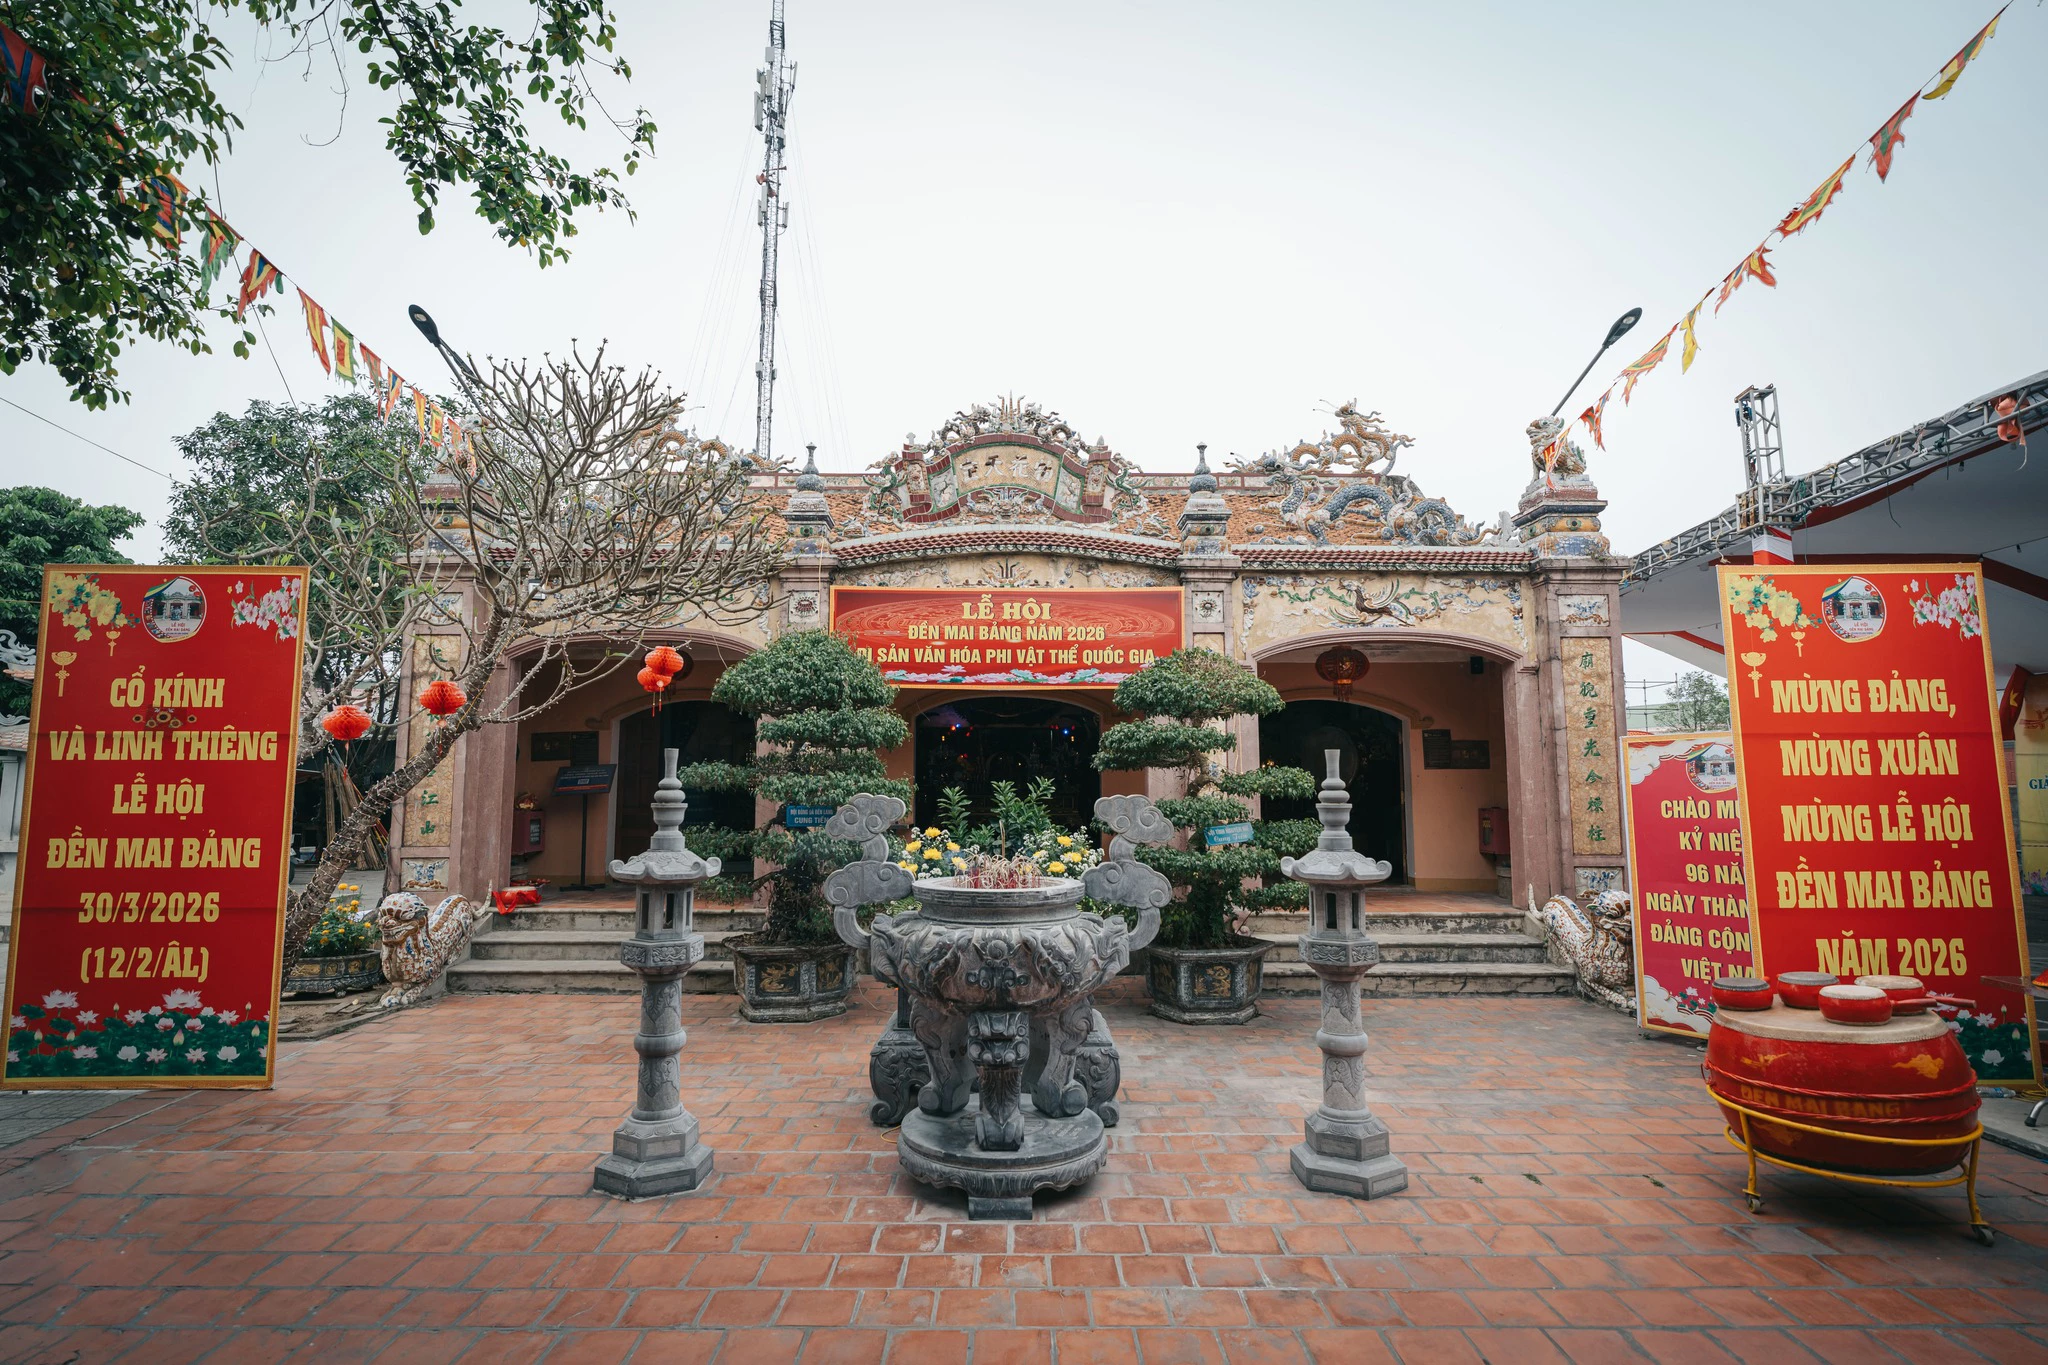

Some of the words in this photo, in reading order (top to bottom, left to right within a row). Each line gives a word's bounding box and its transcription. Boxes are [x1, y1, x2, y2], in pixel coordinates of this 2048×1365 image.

[962, 594, 995, 620] LỄ
[1002, 598, 1051, 625] HỘI
[908, 621, 940, 641] ĐỀN
[944, 626, 974, 641] MAI
[979, 621, 1022, 642] BẢNG
[1026, 623, 1063, 642] NĂM
[1067, 627, 1105, 642] 2026
[877, 643, 910, 663] SẢN
[914, 645, 946, 663] VĂN
[950, 645, 981, 664] HÓA
[986, 649, 1012, 664] PHI
[1017, 646, 1045, 667] VẬT
[1050, 645, 1079, 664] THỂ
[1083, 645, 1124, 665] QUỐC
[1128, 649, 1155, 664] GIA
[110, 665, 146, 707] CỔ
[152, 672, 225, 708] KÍNH
[1771, 673, 1861, 714] MỪNG
[1868, 670, 1957, 718] ĐẢNG,
[49, 724, 86, 760] VÀ
[94, 730, 164, 761] LINH
[171, 724, 278, 761] THIÊNG
[1780, 732, 1872, 776] MỪNG
[1878, 731, 1959, 776] XUÂN
[112, 772, 148, 814] LỄ
[155, 778, 205, 820] HỘI
[1660, 796, 1711, 819] CHÀO
[1781, 797, 1873, 842] MỪNG
[1878, 790, 1917, 842] LỄ
[1921, 797, 1974, 849] HỘI
[46, 826, 108, 868] ĐỀN
[114, 837, 174, 868] MAI
[180, 830, 261, 868] BẢNG
[1679, 825, 1703, 851] KỶ
[1709, 828, 1742, 857] NIỆ
[1685, 863, 1710, 883] 96
[1714, 861, 1745, 885] NĂ
[1776, 856, 1839, 909] ĐỀN
[1844, 870, 1905, 909] MAI
[1909, 860, 1993, 908] BẢNG
[78, 892, 220, 923] 30/3/2026
[1645, 890, 1697, 914] NGÀY
[1700, 894, 1748, 918] THÀN
[1650, 918, 1703, 947] ĐẢNG
[1708, 926, 1751, 954] CỘN
[1816, 930, 1891, 976] NĂM
[1897, 938, 1967, 976] 2026
[81, 941, 209, 983] (12/2/ÂL)
[1681, 956, 1722, 985] VIỆT
[1728, 964, 1754, 979] NA
